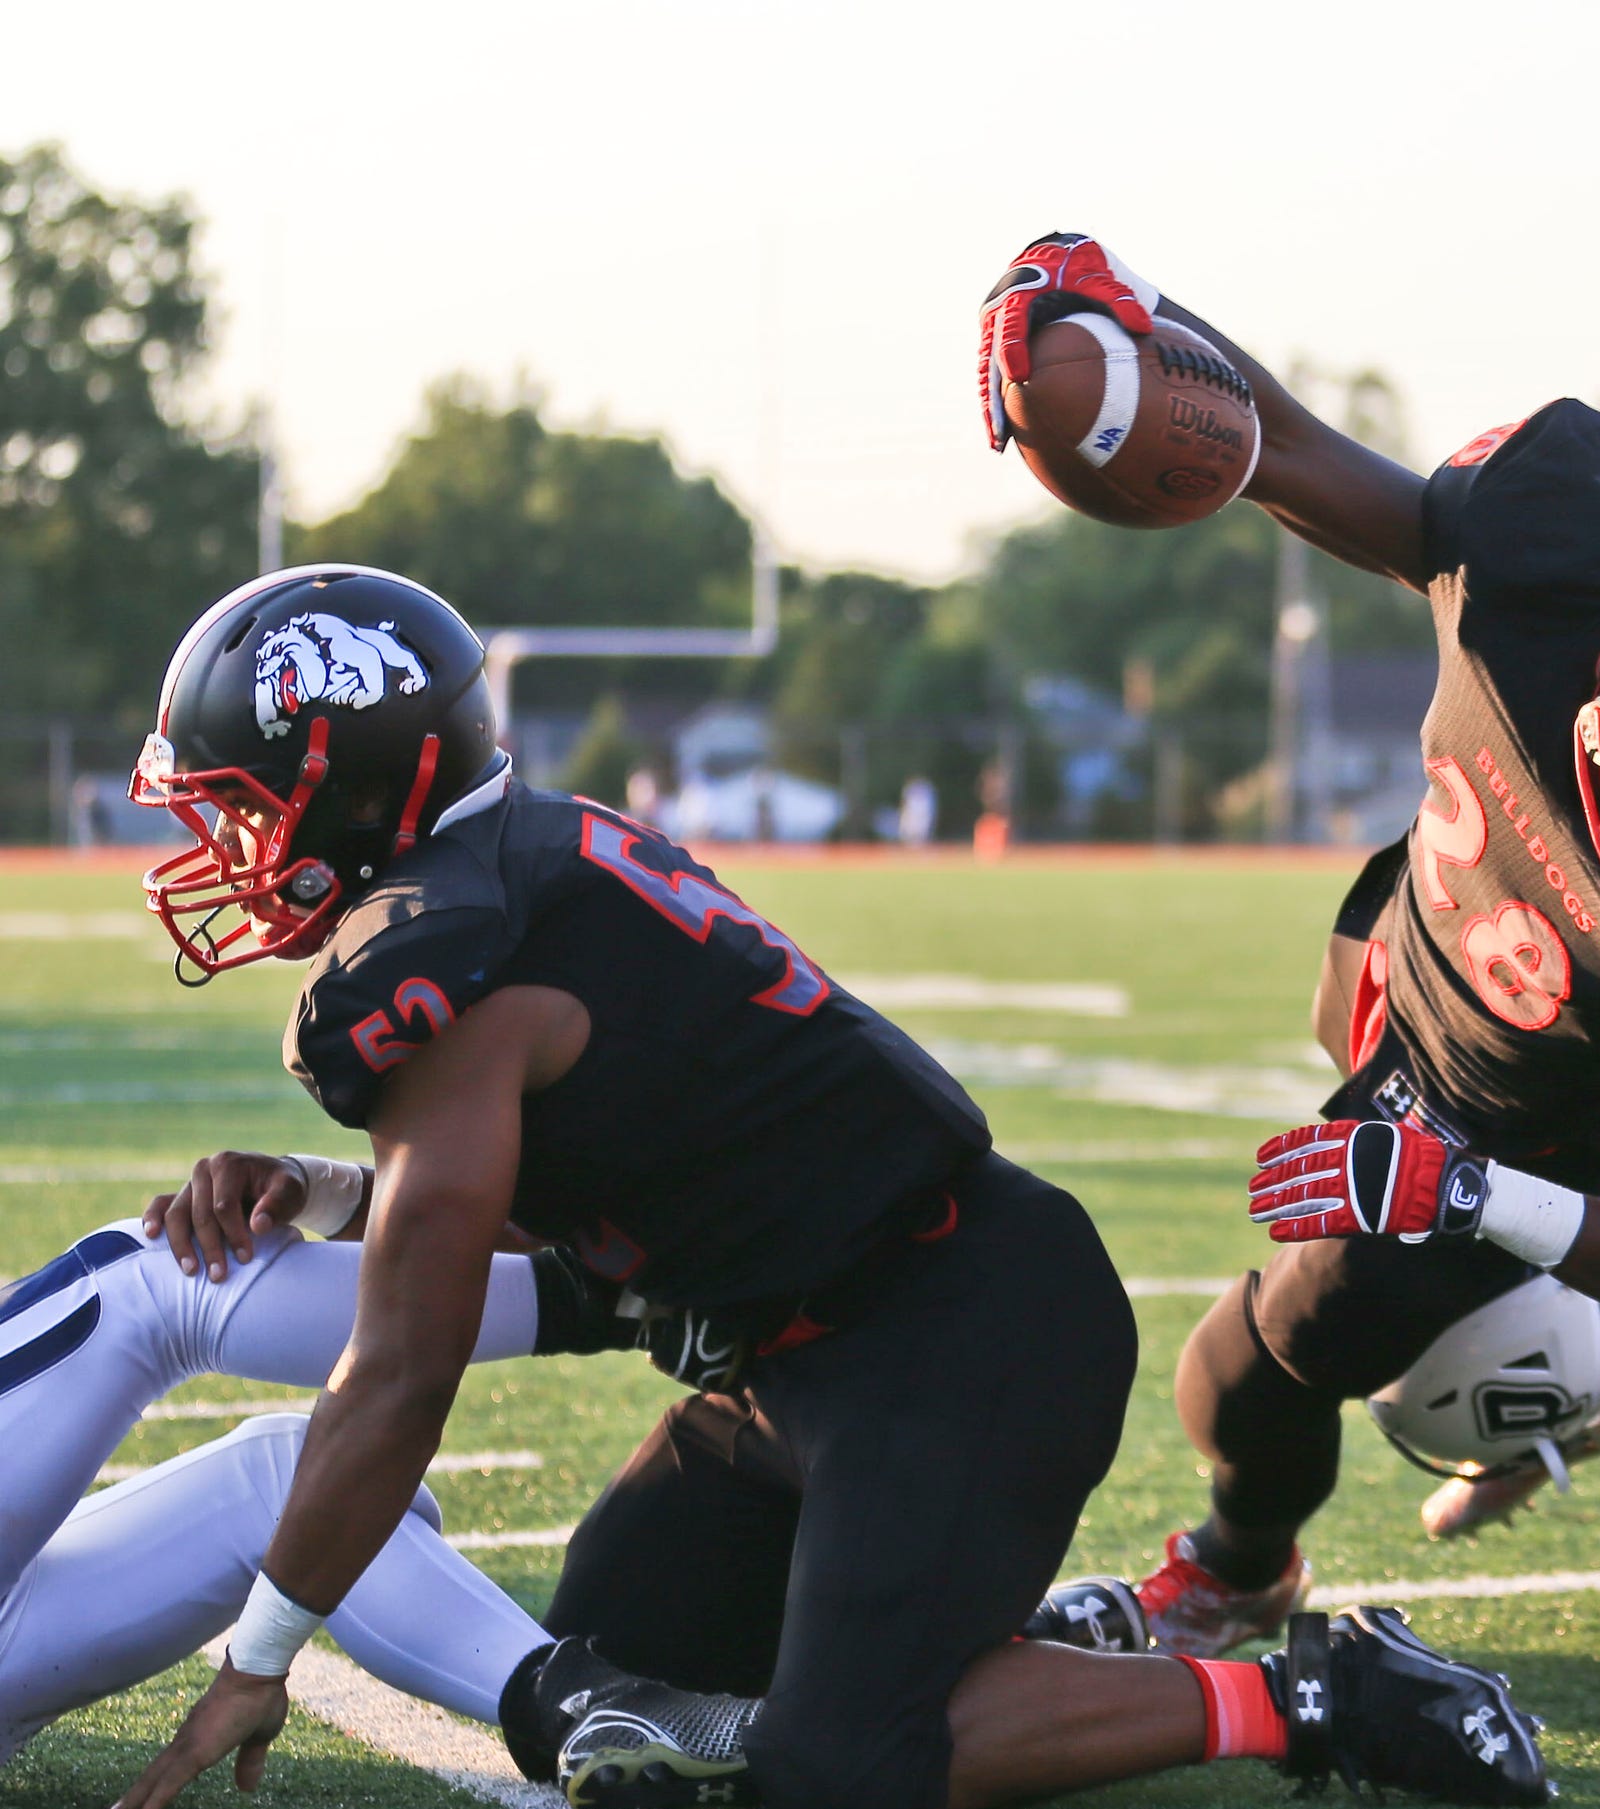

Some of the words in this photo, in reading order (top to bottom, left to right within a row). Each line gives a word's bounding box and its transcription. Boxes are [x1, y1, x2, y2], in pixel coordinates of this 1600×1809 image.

[1167, 393, 1243, 451] Wilson
[1417, 755, 1573, 1032] 28
[1475, 746, 1596, 933] BULLDOGS
